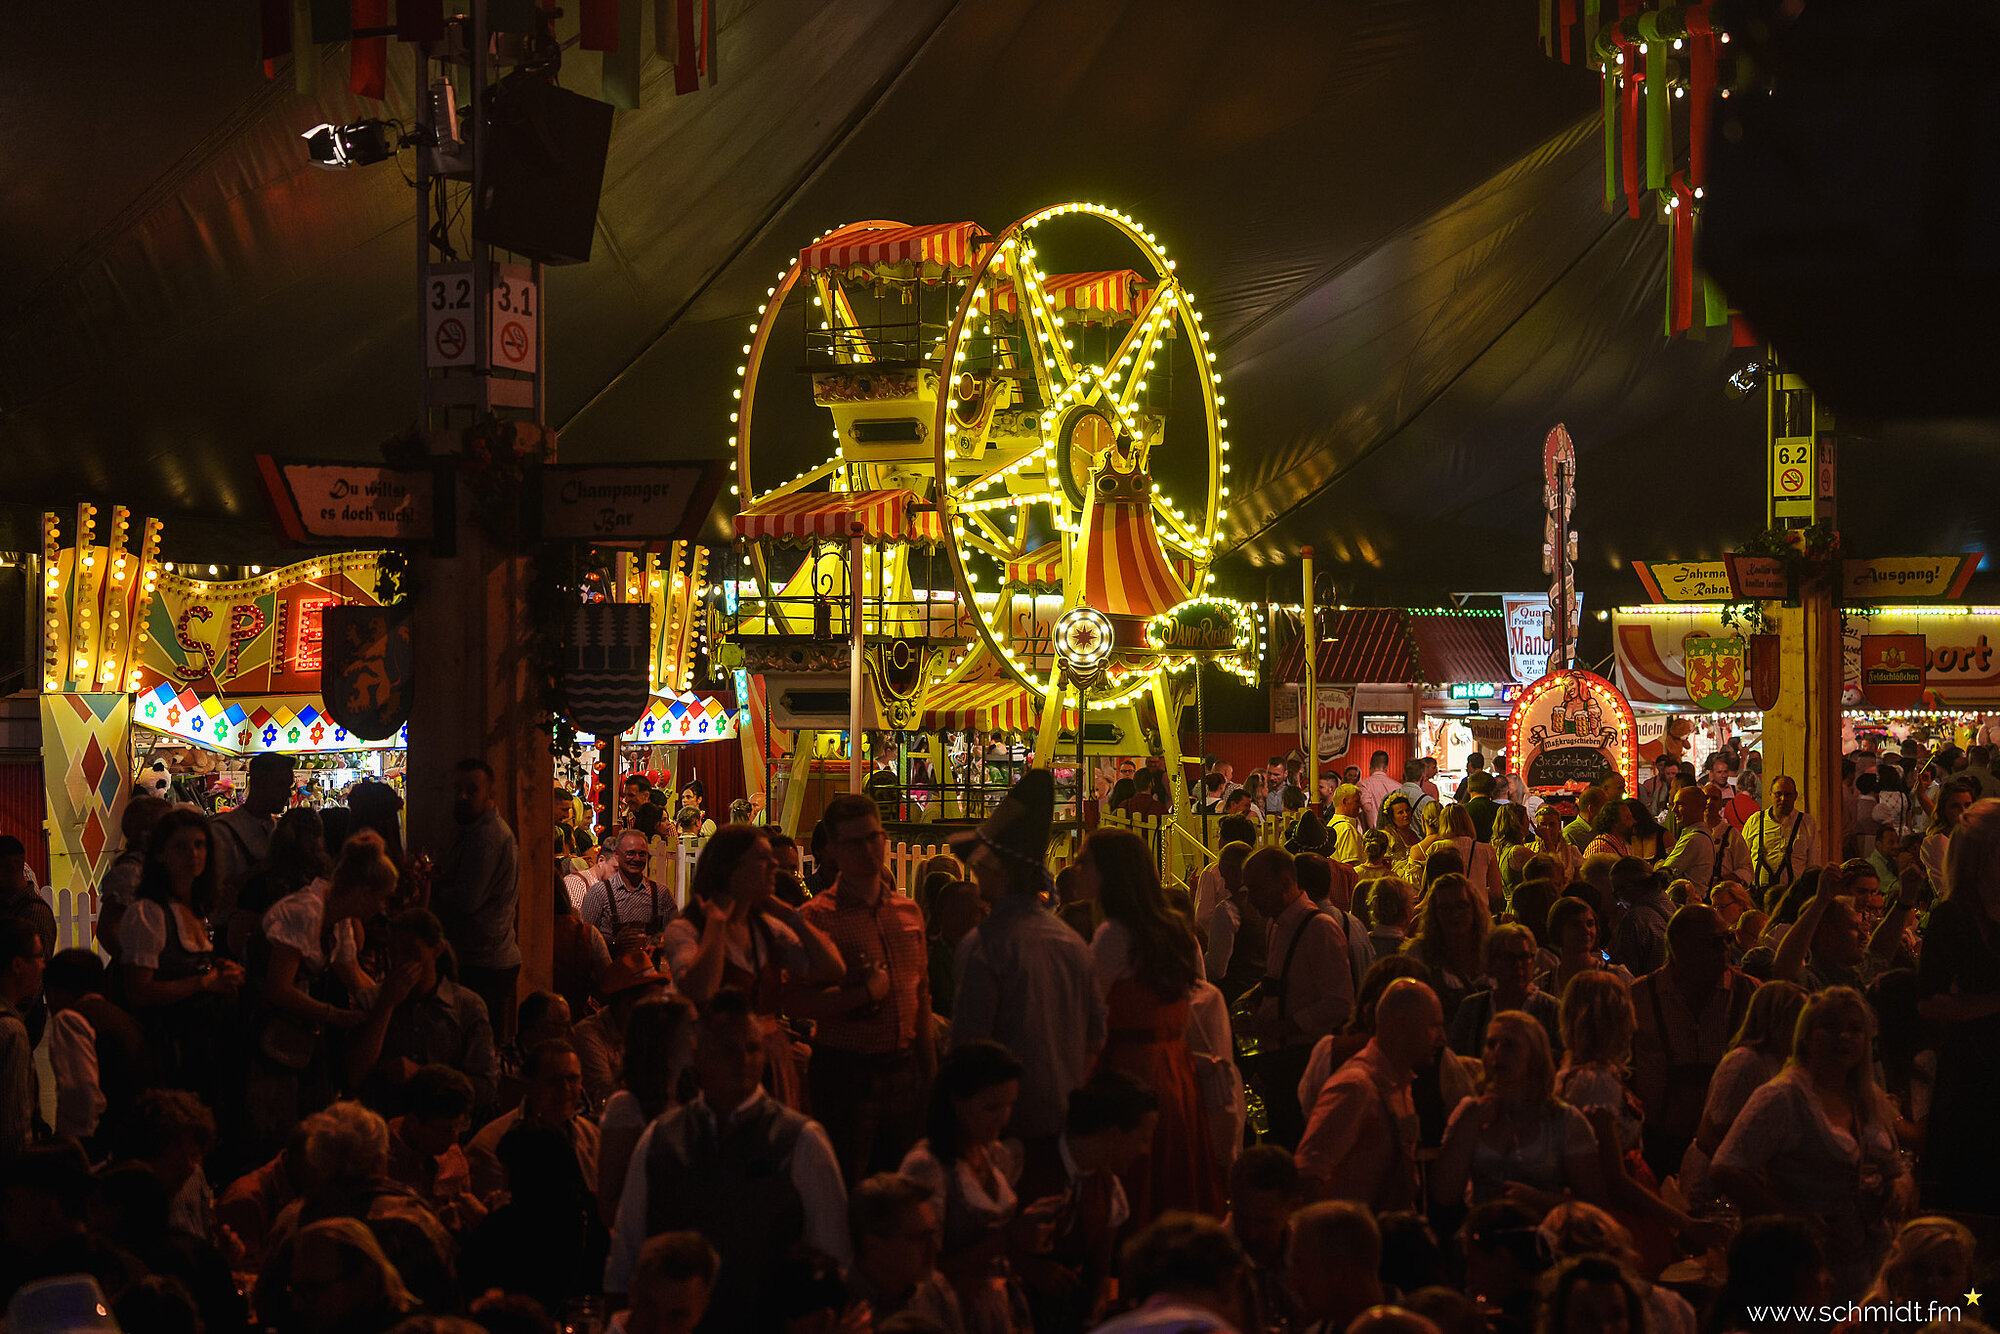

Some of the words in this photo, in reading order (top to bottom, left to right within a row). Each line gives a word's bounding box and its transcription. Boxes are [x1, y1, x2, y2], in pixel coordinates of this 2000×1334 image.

[432, 279, 470, 310] 3.2
[498, 282, 532, 316] 3.1
[1778, 447, 1807, 464] 6.2
[329, 479, 358, 499] Du
[365, 480, 406, 497] willst
[321, 508, 336, 520] es
[342, 505, 373, 521] doch
[379, 506, 414, 521] auch!
[594, 508, 633, 532] Bar
[1673, 567, 1726, 583] Jahrma
[1853, 566, 1940, 585] Ausgang!
[1694, 582, 1731, 596] Rabat
[1867, 670, 1920, 683] Feldschlößchen
[1301, 702, 1353, 734] Cêpes
